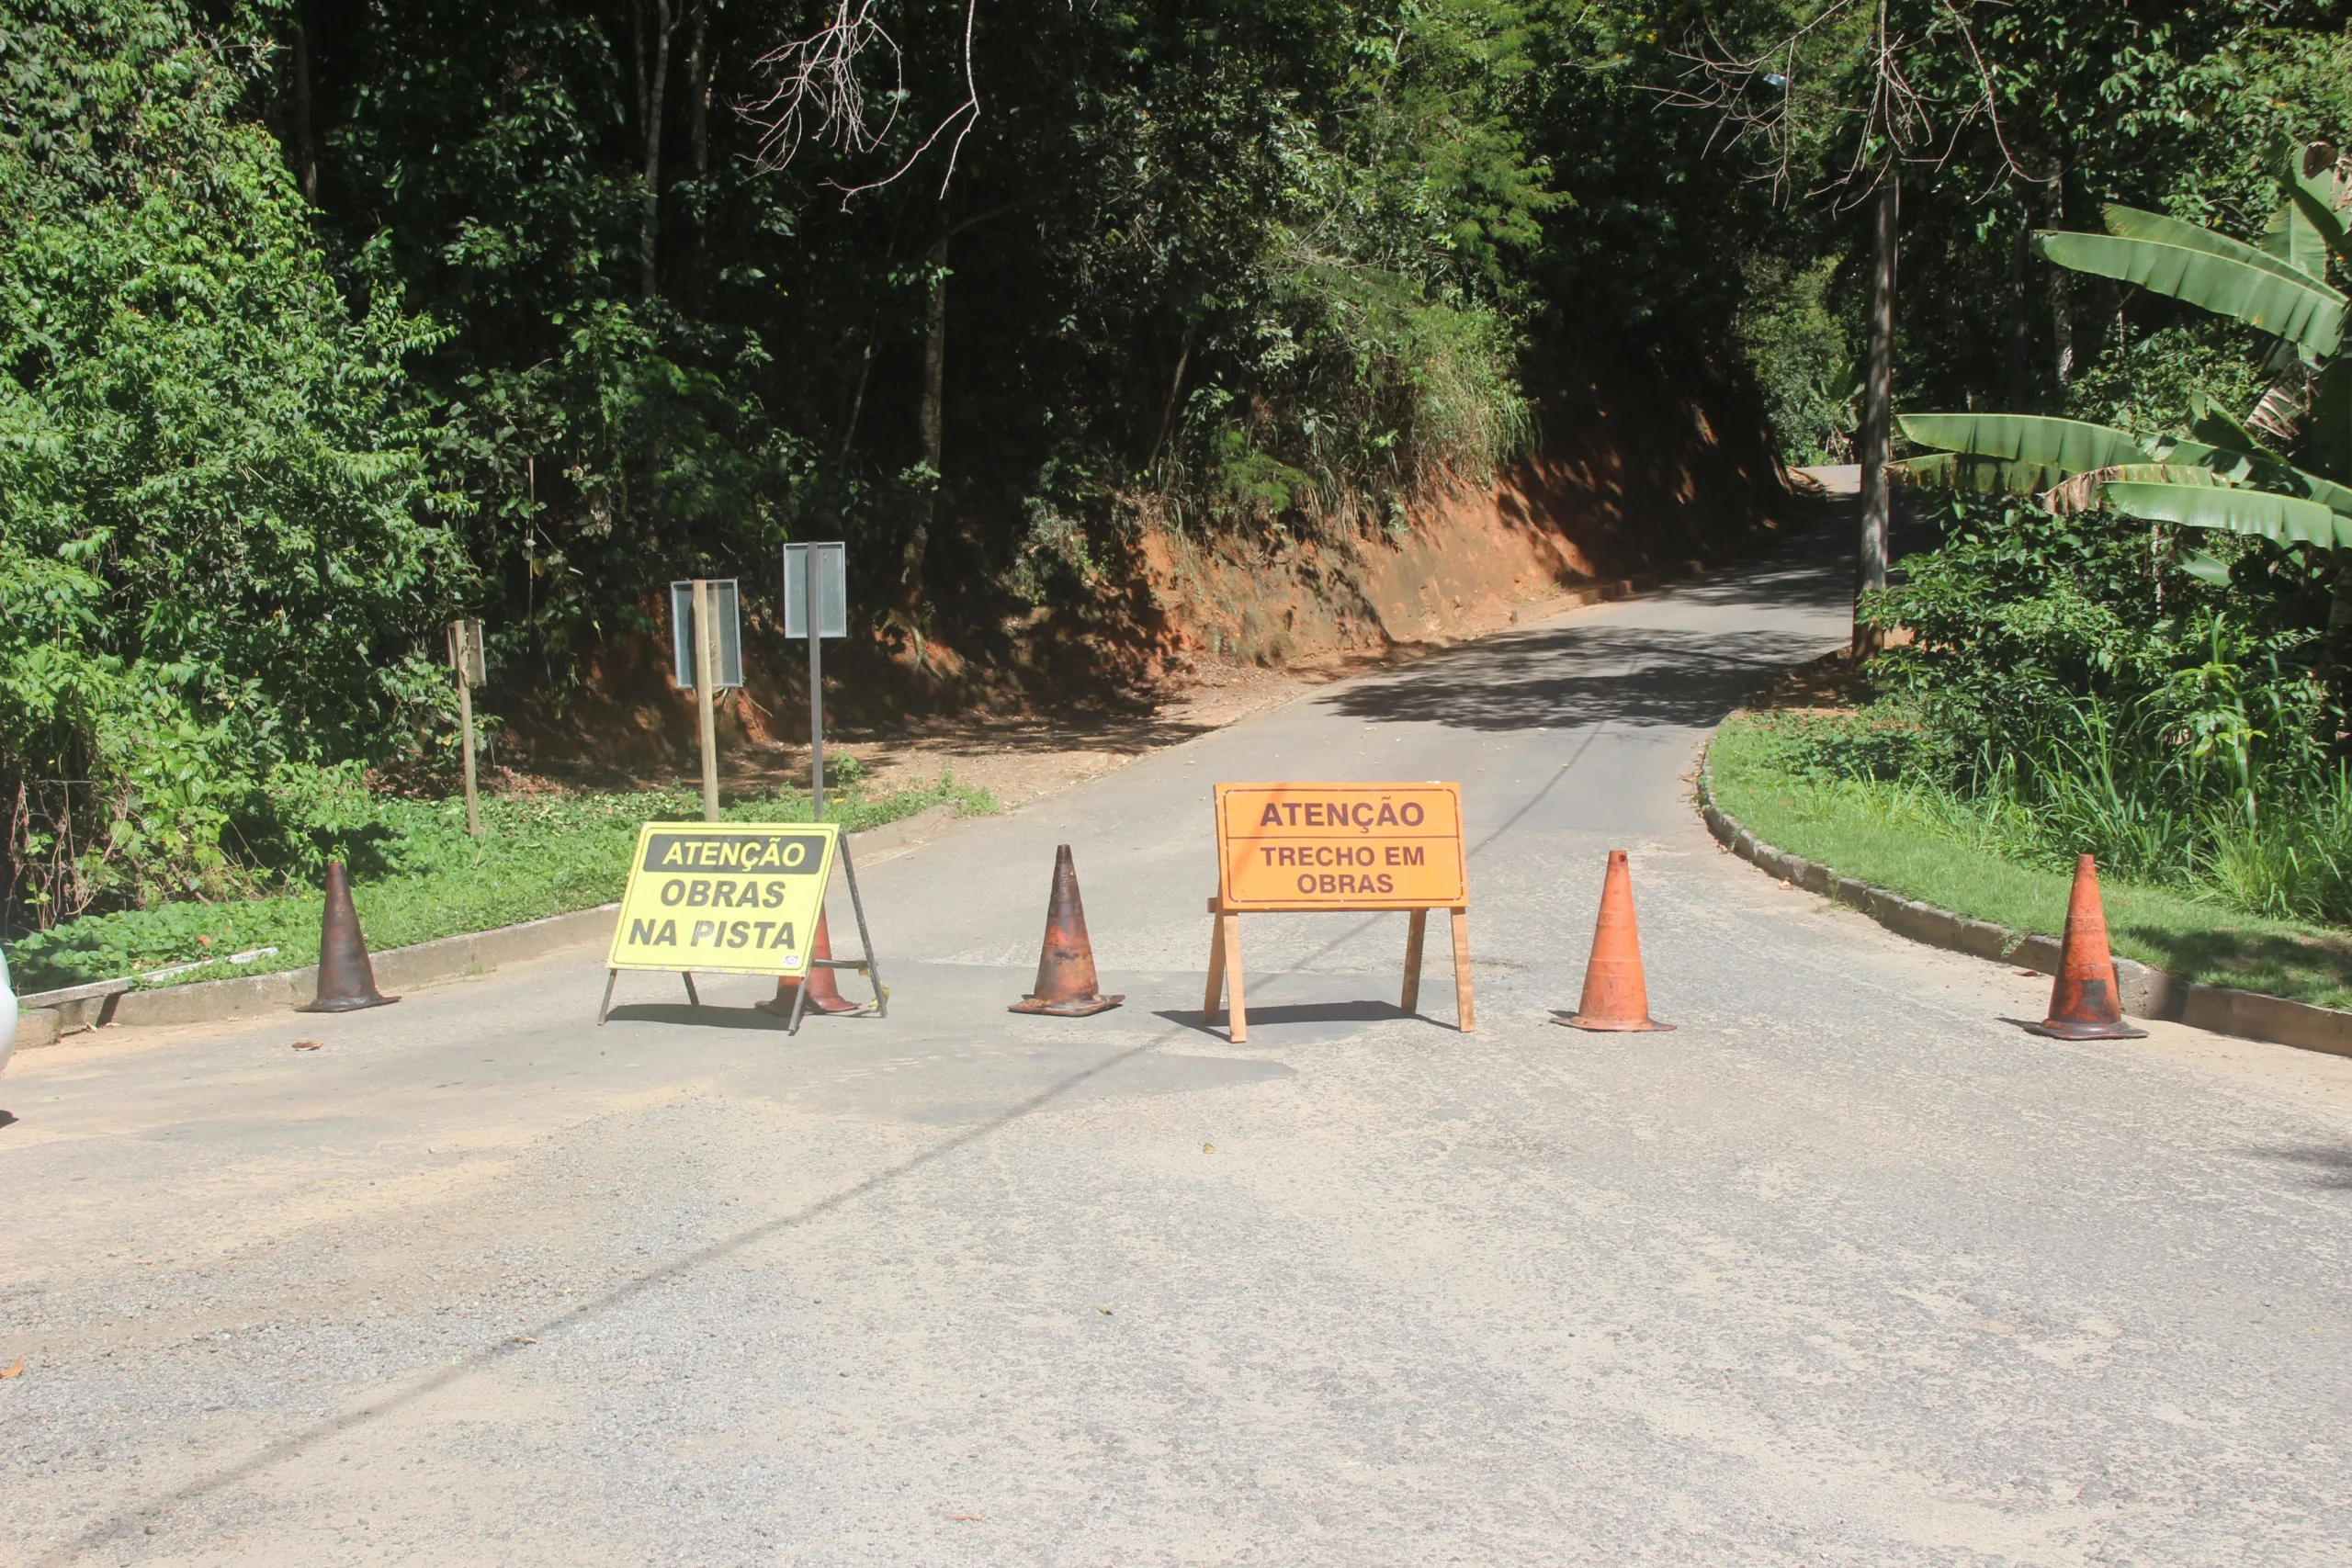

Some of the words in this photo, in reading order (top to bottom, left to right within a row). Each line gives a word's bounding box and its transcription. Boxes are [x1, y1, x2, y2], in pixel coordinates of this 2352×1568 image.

[1260, 796, 1424, 833] ATENÇÃO
[662, 837, 806, 872] ATENÇÃO
[1260, 846, 1375, 867] TRECHO
[1385, 846, 1425, 866] EM
[661, 879, 786, 908] OBRAS
[1296, 874, 1394, 894] OBRAS
[628, 919, 677, 946] NA
[690, 920, 796, 950] PISTA
